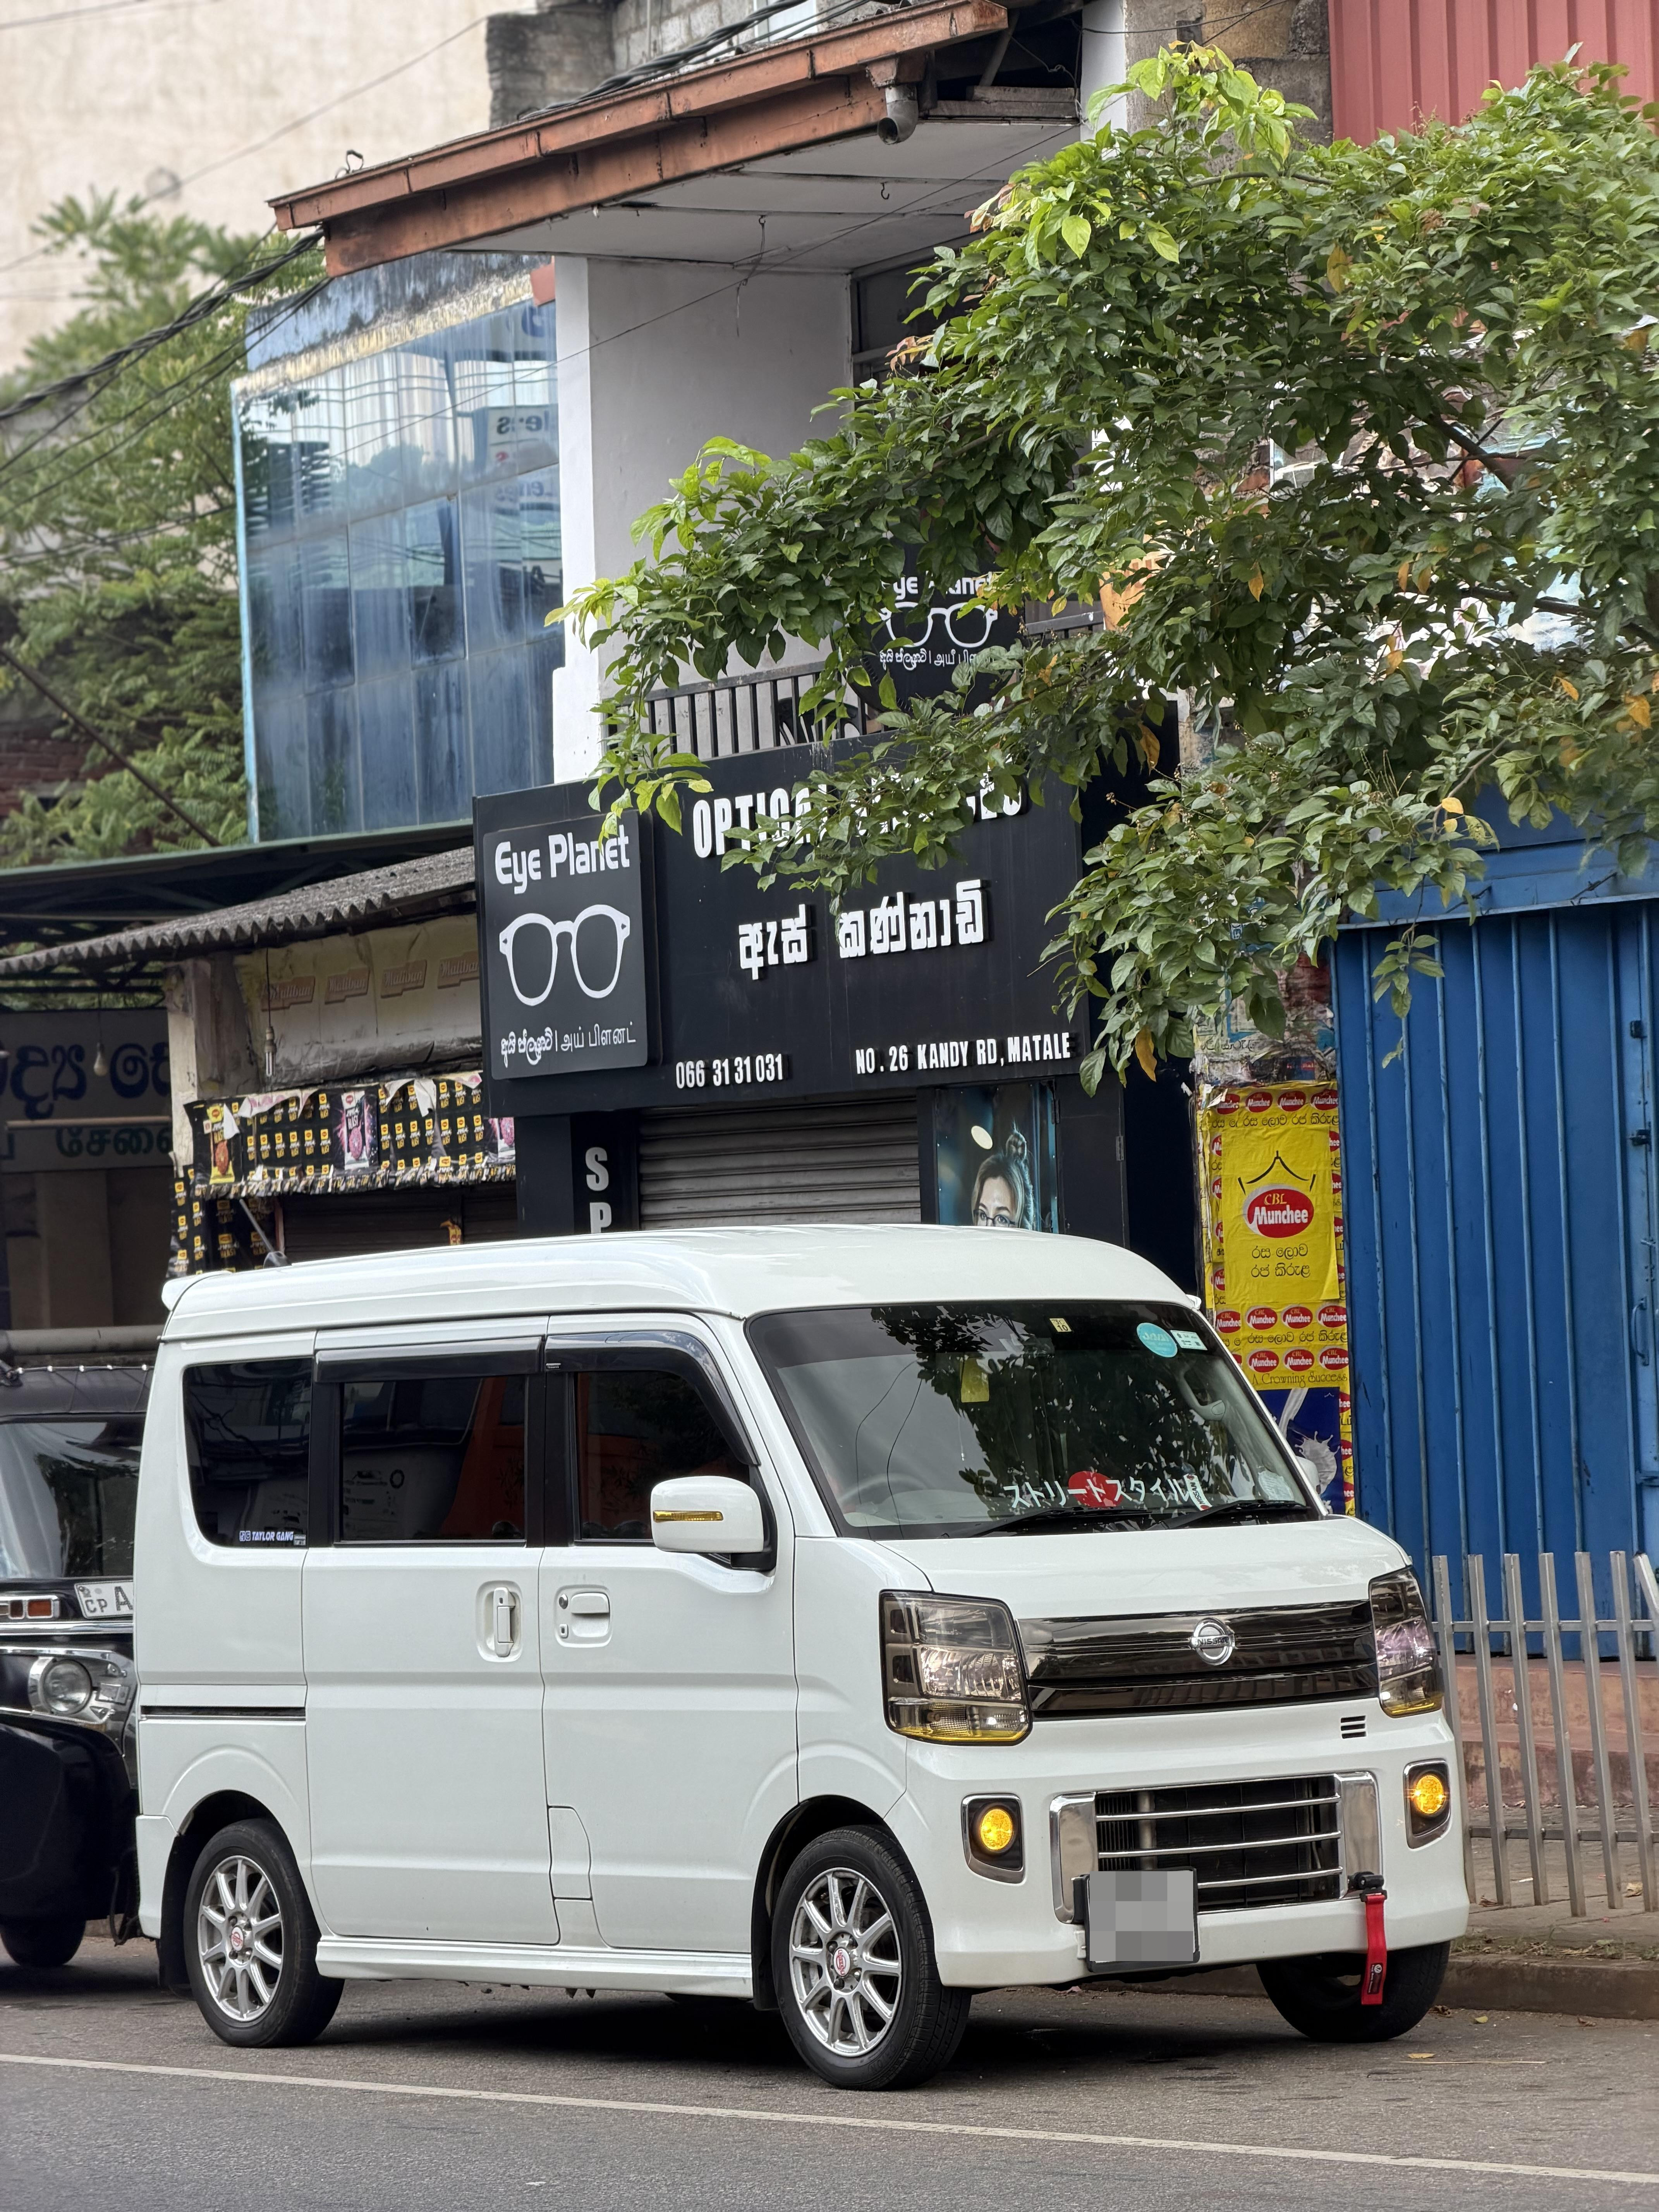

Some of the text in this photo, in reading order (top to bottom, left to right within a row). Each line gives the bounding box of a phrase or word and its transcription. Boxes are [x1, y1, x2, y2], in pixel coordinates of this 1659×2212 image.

[881, 576, 918, 600] ye
[495, 824, 630, 894] Eye Planet
[889, 1045, 908, 1072] 26
[917, 1041, 969, 1070] KANDY
[676, 1053, 783, 1089] 066 31 31 031
[1243, 1115, 1258, 1127] රස
[1264, 1193, 1287, 1206] CBL
[1254, 1204, 1309, 1225] Munchee
[1252, 1243, 1308, 1260] රස ලොව
[1217, 1317, 1241, 1328] Munchee
[1250, 1315, 1275, 1324] Munchee
[1286, 1314, 1311, 1323] Munchee
[1321, 1312, 1347, 1322] Munchee
[1248, 1333, 1263, 1343] රස
[1267, 1331, 1294, 1345] ලොව
[1252, 1357, 1277, 1367] Munchee
[1288, 1356, 1312, 1365] Munchee
[1322, 1355, 1349, 1364] Munchee
[1262, 1373, 1306, 1388] Crowning
[1308, 1370, 1348, 1383] Success
[1003, 1475, 1189, 1508] ストリートスタイル
[1190, 1482, 1206, 1504] NISSAN
[252, 1531, 275, 1541] TAYLOR
[276, 1531, 294, 1541] GANG
[85, 1599, 108, 1613] CP
[1197, 1636, 1229, 1645] NISSAN
